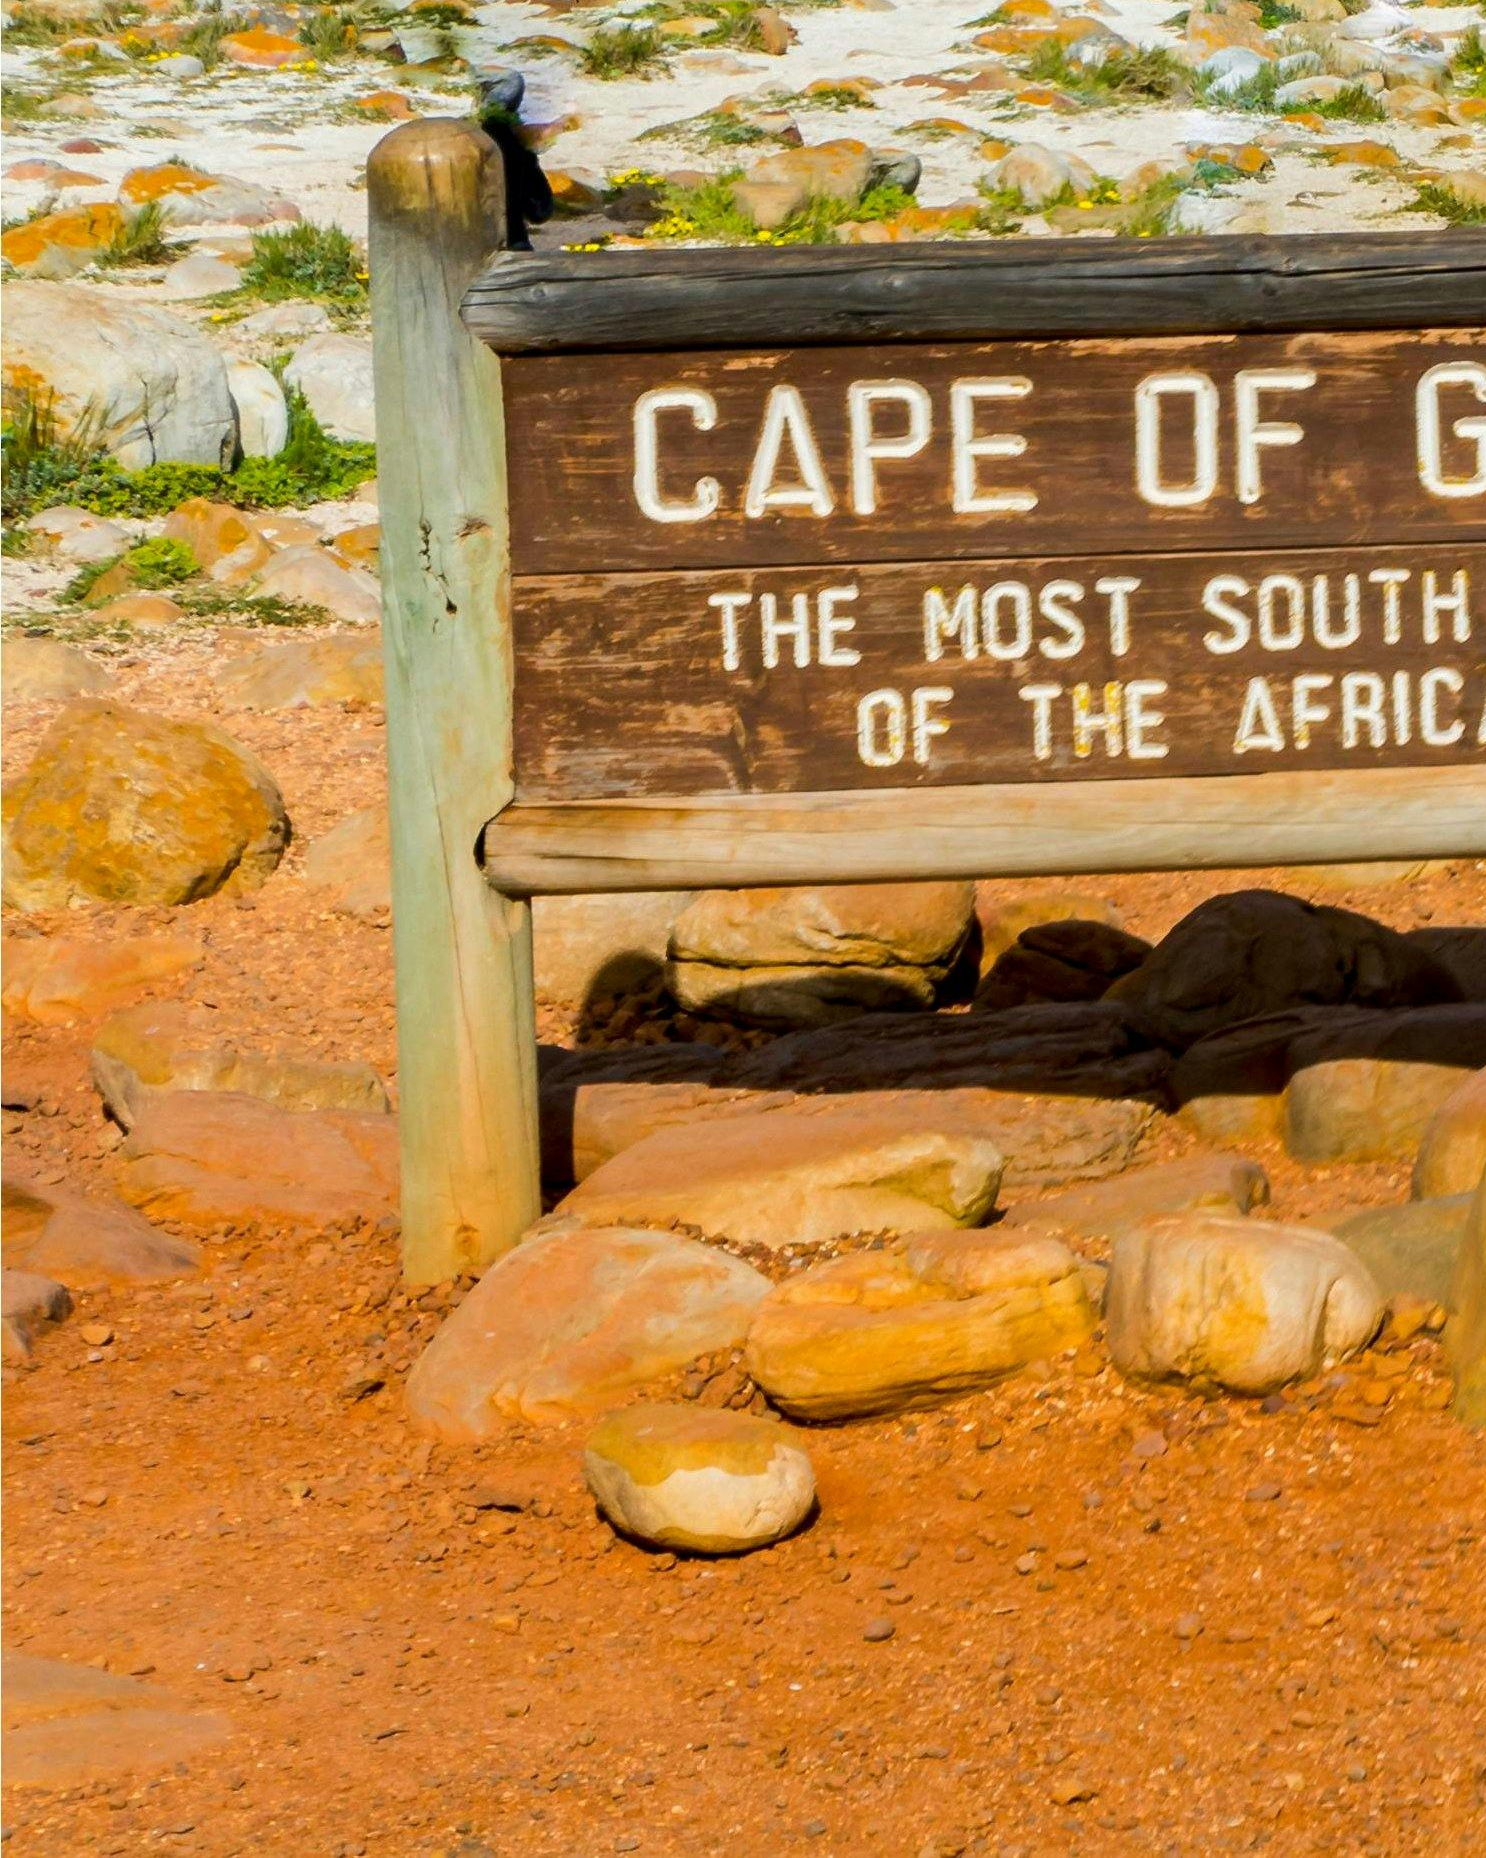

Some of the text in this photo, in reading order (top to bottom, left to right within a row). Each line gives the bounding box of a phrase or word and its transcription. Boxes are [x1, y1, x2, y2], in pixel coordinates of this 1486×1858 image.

[632, 375, 1039, 524] CAPE
[1133, 367, 1318, 509] OF
[707, 585, 863, 672] THE
[923, 577, 1142, 664] MOST
[857, 686, 956, 768] OF
[1019, 680, 1171, 761] THE
